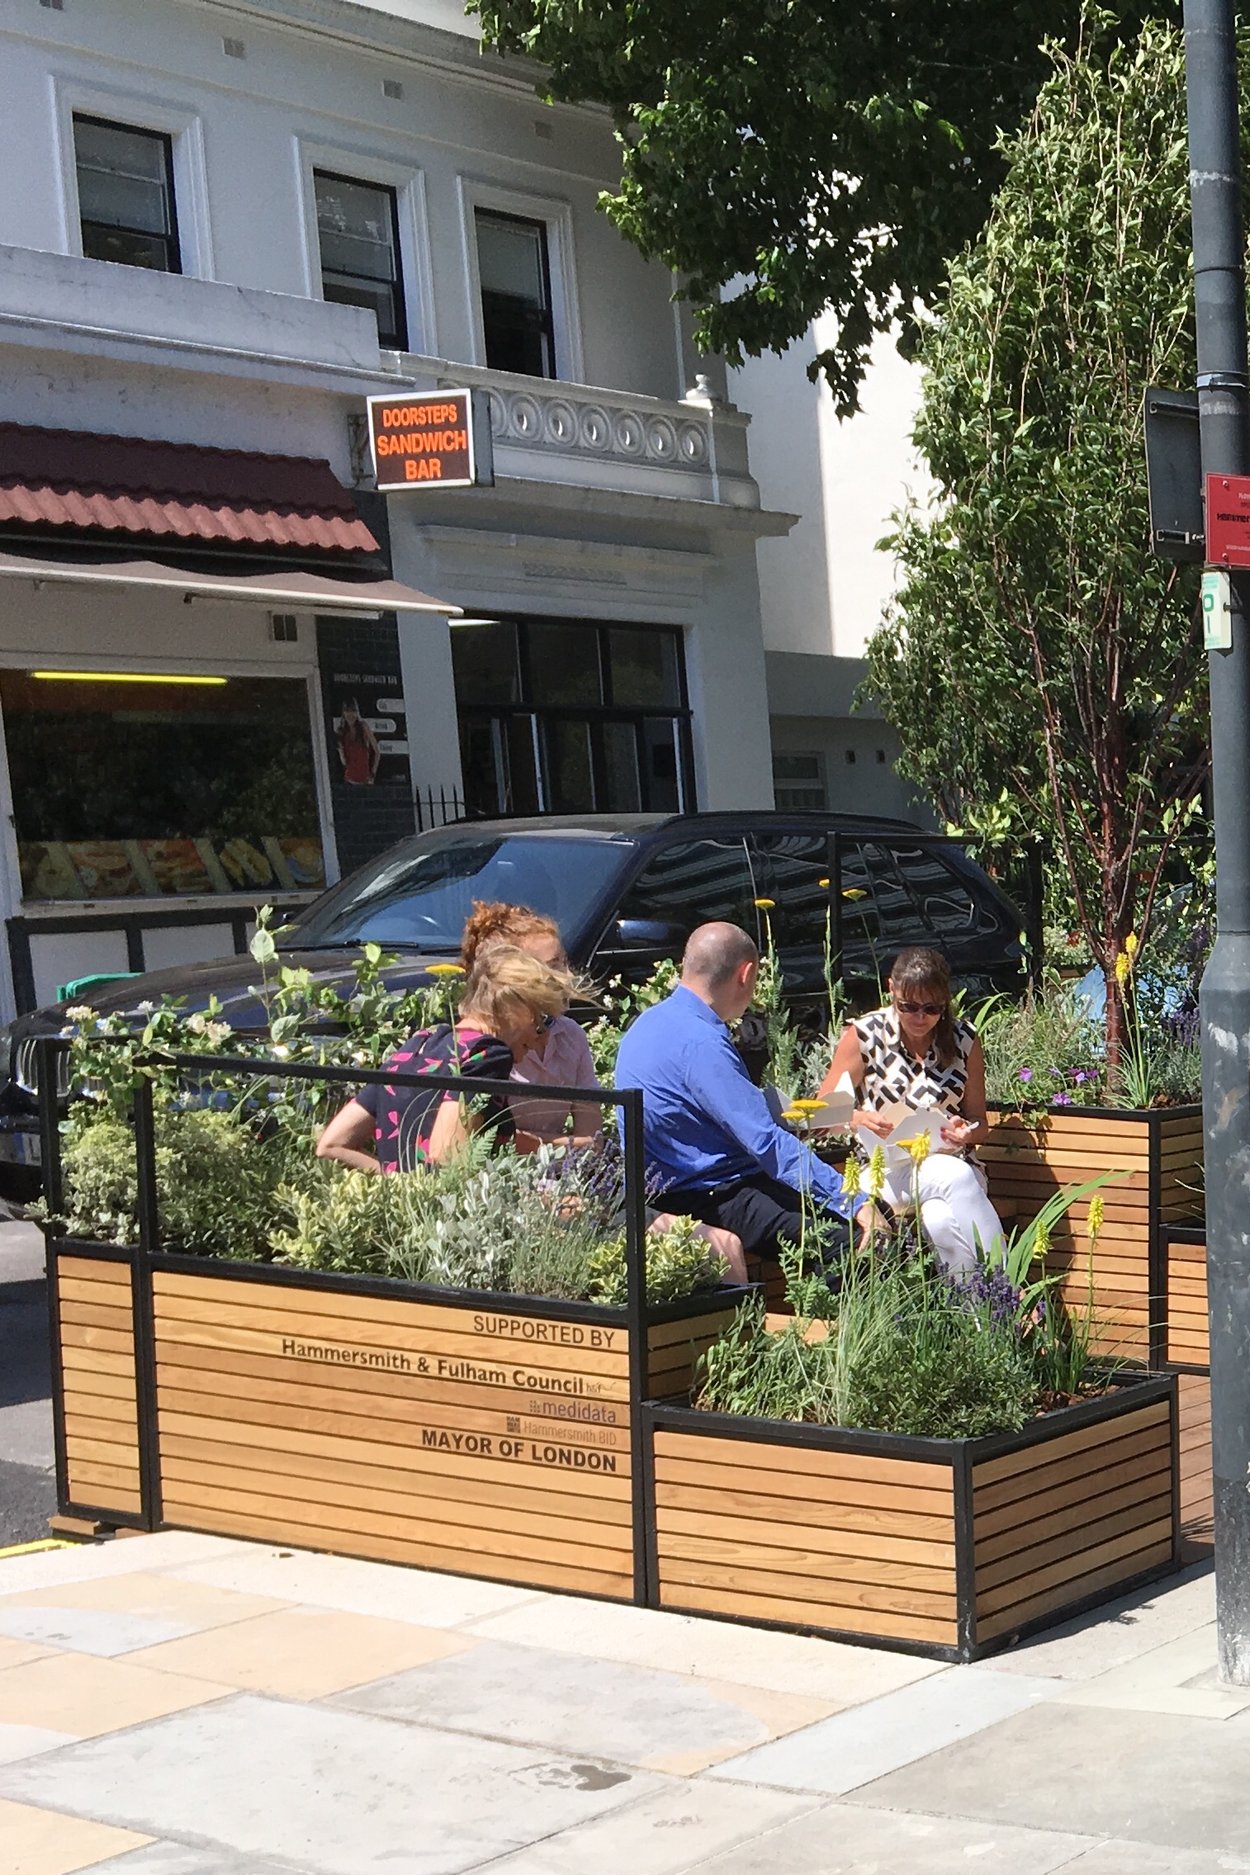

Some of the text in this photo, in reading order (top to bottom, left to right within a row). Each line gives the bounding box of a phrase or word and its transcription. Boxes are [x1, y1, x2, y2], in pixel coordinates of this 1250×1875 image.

[382, 404, 458, 428] DOORSTEPS
[377, 430, 467, 456] SANDWICH
[405, 458, 441, 480] BAR
[474, 1315, 616, 1347] SUPPORTED BY
[282, 1338, 411, 1370] Hammersmith
[417, 1357, 430, 1373] &
[438, 1359, 507, 1384] Fulham
[512, 1370, 584, 1394] Council
[542, 1401, 617, 1424] medidata
[524, 1421, 596, 1443] Hammersmith
[599, 1430, 617, 1446] BID
[422, 1429, 492, 1454] MAYOR
[498, 1439, 525, 1457] OF
[531, 1444, 616, 1472] LONDON
